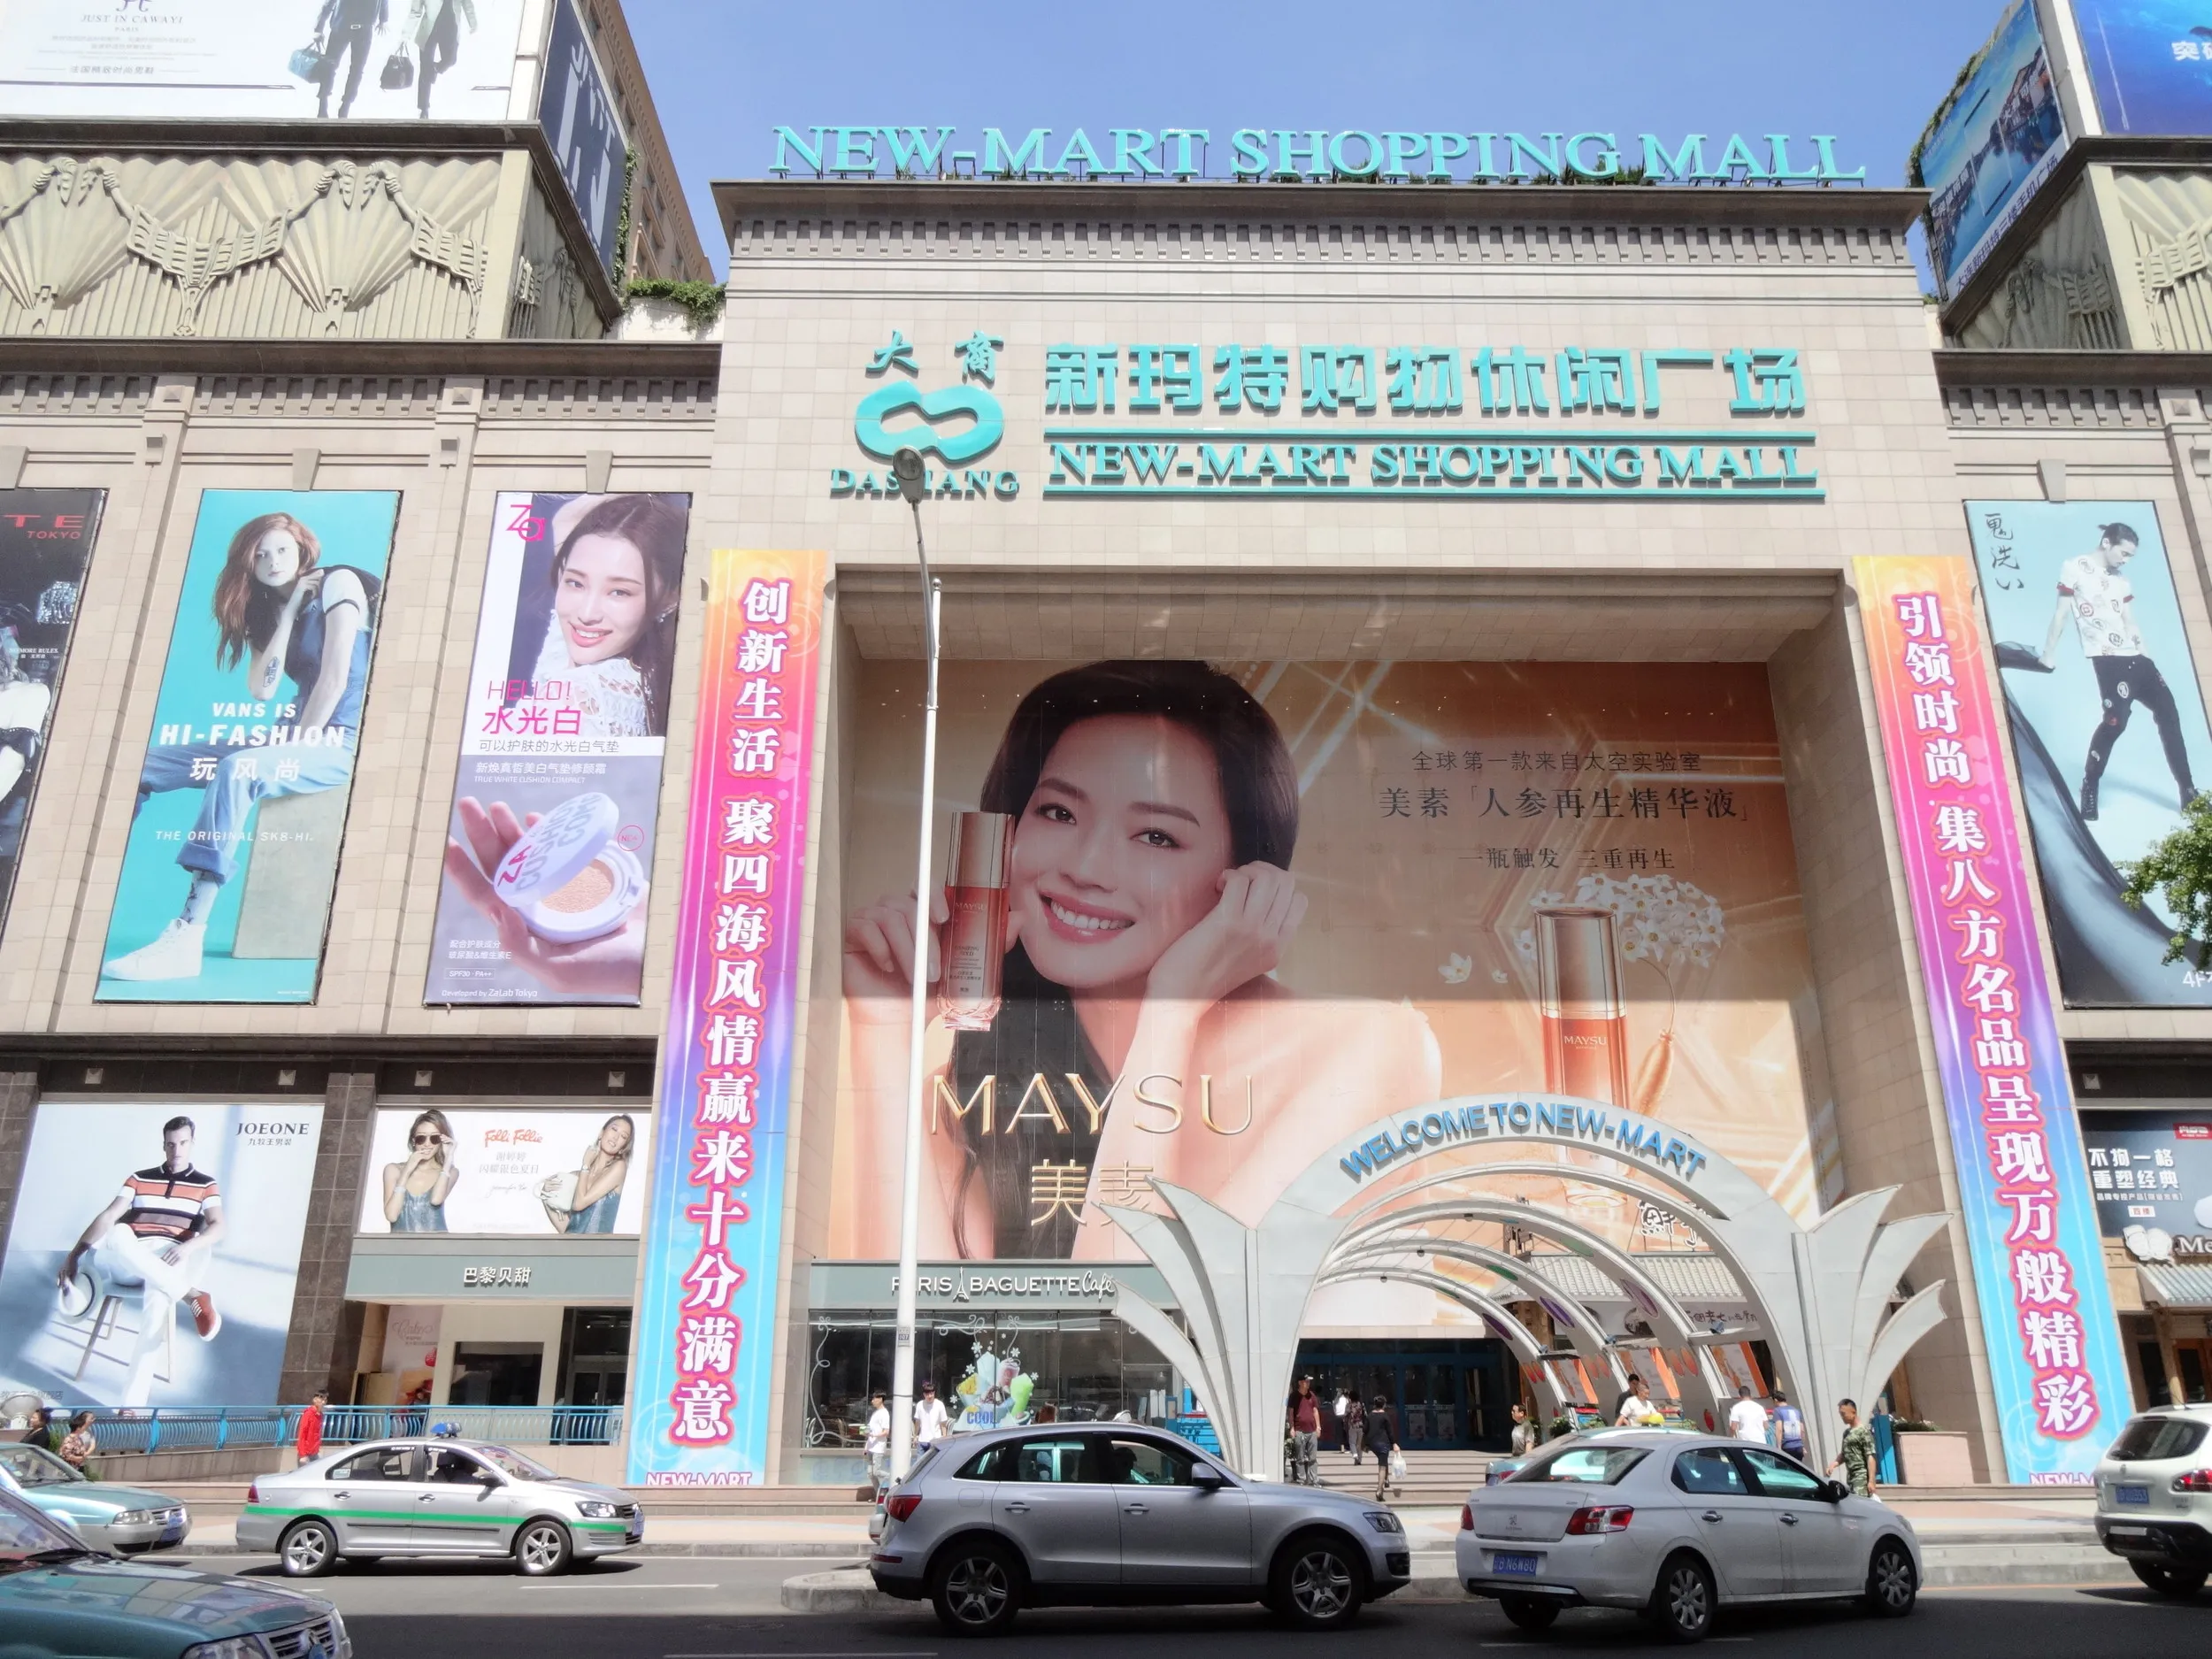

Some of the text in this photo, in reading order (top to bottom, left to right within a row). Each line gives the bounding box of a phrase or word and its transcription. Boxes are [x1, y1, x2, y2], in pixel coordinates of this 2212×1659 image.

[768, 126, 1210, 176] NEW-MART
[1230, 129, 1622, 179] SHOPPING
[1639, 134, 1866, 180] MALL
[865, 328, 1004, 383] 大商
[1046, 342, 1807, 414] 新玛特购物休闲广场
[1050, 443, 1818, 485] NEW-MART SHOPPING MALL
[831, 469, 1020, 497] DASANG
[506, 504, 547, 541] Za
[27, 531, 81, 540] TOKYO
[488, 680, 572, 701] HELLO!
[211, 703, 296, 718] VANS IS
[481, 705, 582, 735] 水光白
[159, 724, 345, 747] HI-FASHION
[480, 739, 619, 753] 可以护肤的水光白气垫
[189, 757, 301, 782] 玩风尚
[1411, 750, 1701, 772] 全球第一款来自太空实验室
[1379, 785, 1748, 822] 美素「人参再生精华液」
[156, 830, 180, 841] THE
[187, 831, 254, 842] ORIGINAL
[1458, 847, 1676, 870] 一瓶触发 三重再生
[488, 988, 513, 997] ZaLab
[515, 988, 538, 998] Tokyo
[675, 581, 790, 1440] 创新生活 聚四海风情赢来十分满意
[1897, 595, 2094, 1433] 引领时尚 集八方名品呈现万般精彩
[1564, 1035, 1608, 1046] MAYSU
[931, 1072, 1253, 1136] MAYSU
[235, 1122, 310, 1136] JOEONE
[485, 1129, 543, 1148] Folli Follie
[1340, 1101, 1707, 1179] WELCOME TO NEW-MART
[2093, 1170, 2179, 1189] 重塑经典
[463, 1266, 532, 1285] 巴黎贝甜
[970, 1276, 1080, 1293] BAGUETTE
